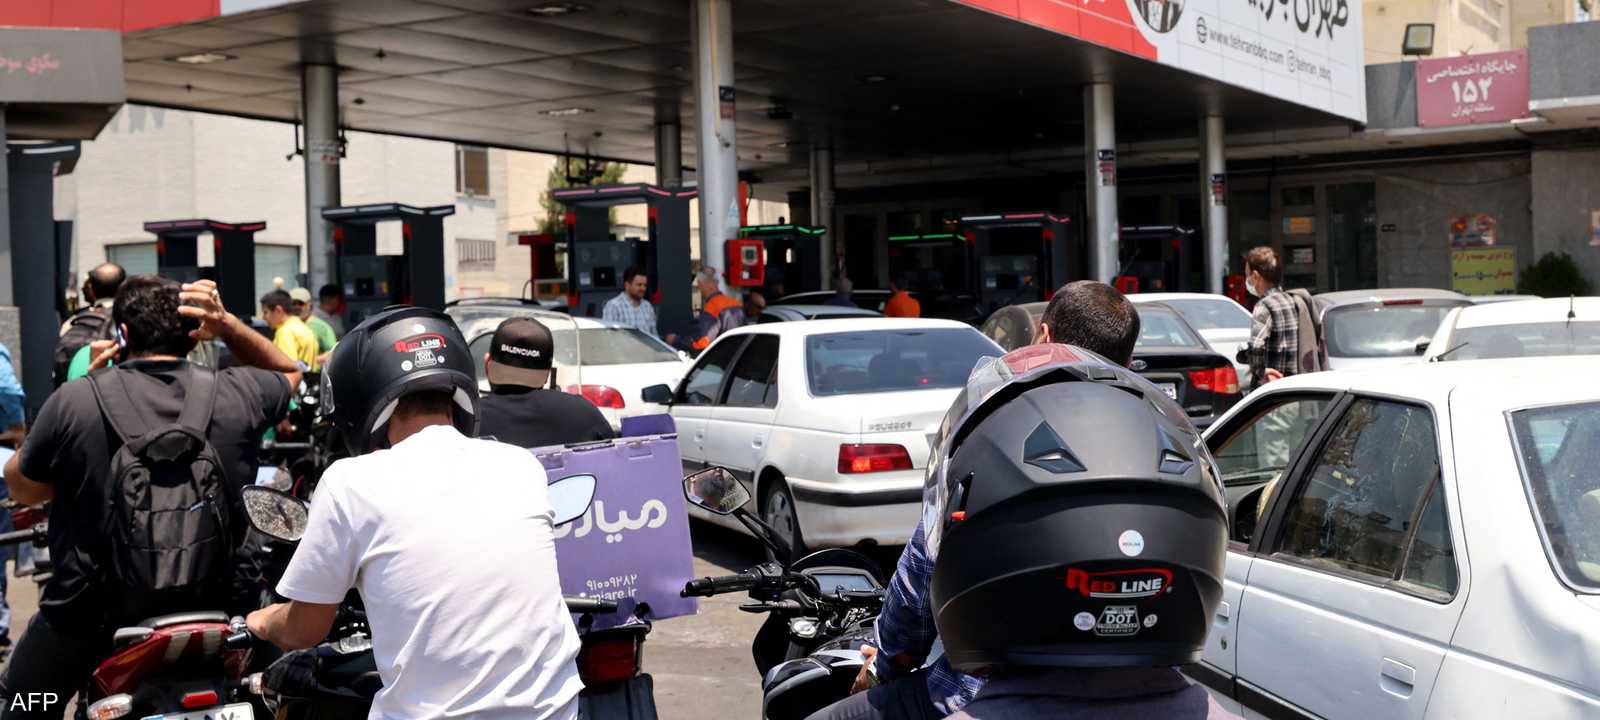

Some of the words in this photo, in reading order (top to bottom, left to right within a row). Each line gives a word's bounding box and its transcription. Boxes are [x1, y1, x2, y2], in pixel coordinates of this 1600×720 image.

[1427, 63, 1480, 83] اختصاصی
[1480, 59, 1518, 75] جایگاه
[1452, 77, 1493, 103] ۱۵۲
[501, 344, 540, 358] BALENCIAGA
[1066, 567, 1117, 597] RED
[1121, 578, 1163, 593] LINE
[1106, 614, 1134, 625] DOT
